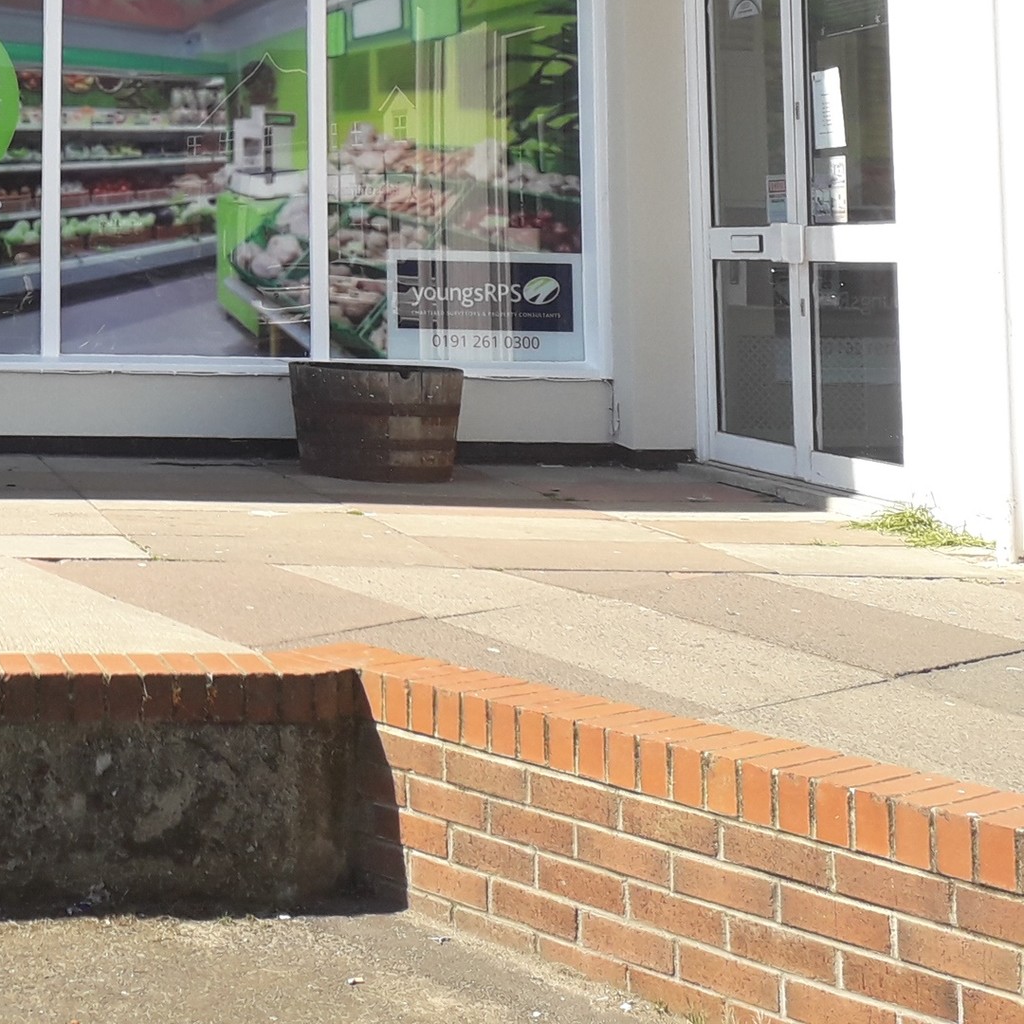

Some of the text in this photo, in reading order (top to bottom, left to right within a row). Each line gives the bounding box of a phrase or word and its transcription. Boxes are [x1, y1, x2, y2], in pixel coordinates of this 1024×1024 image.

[411, 282, 522, 308] youngsRPS
[432, 334, 540, 349] 0191 261 0300
